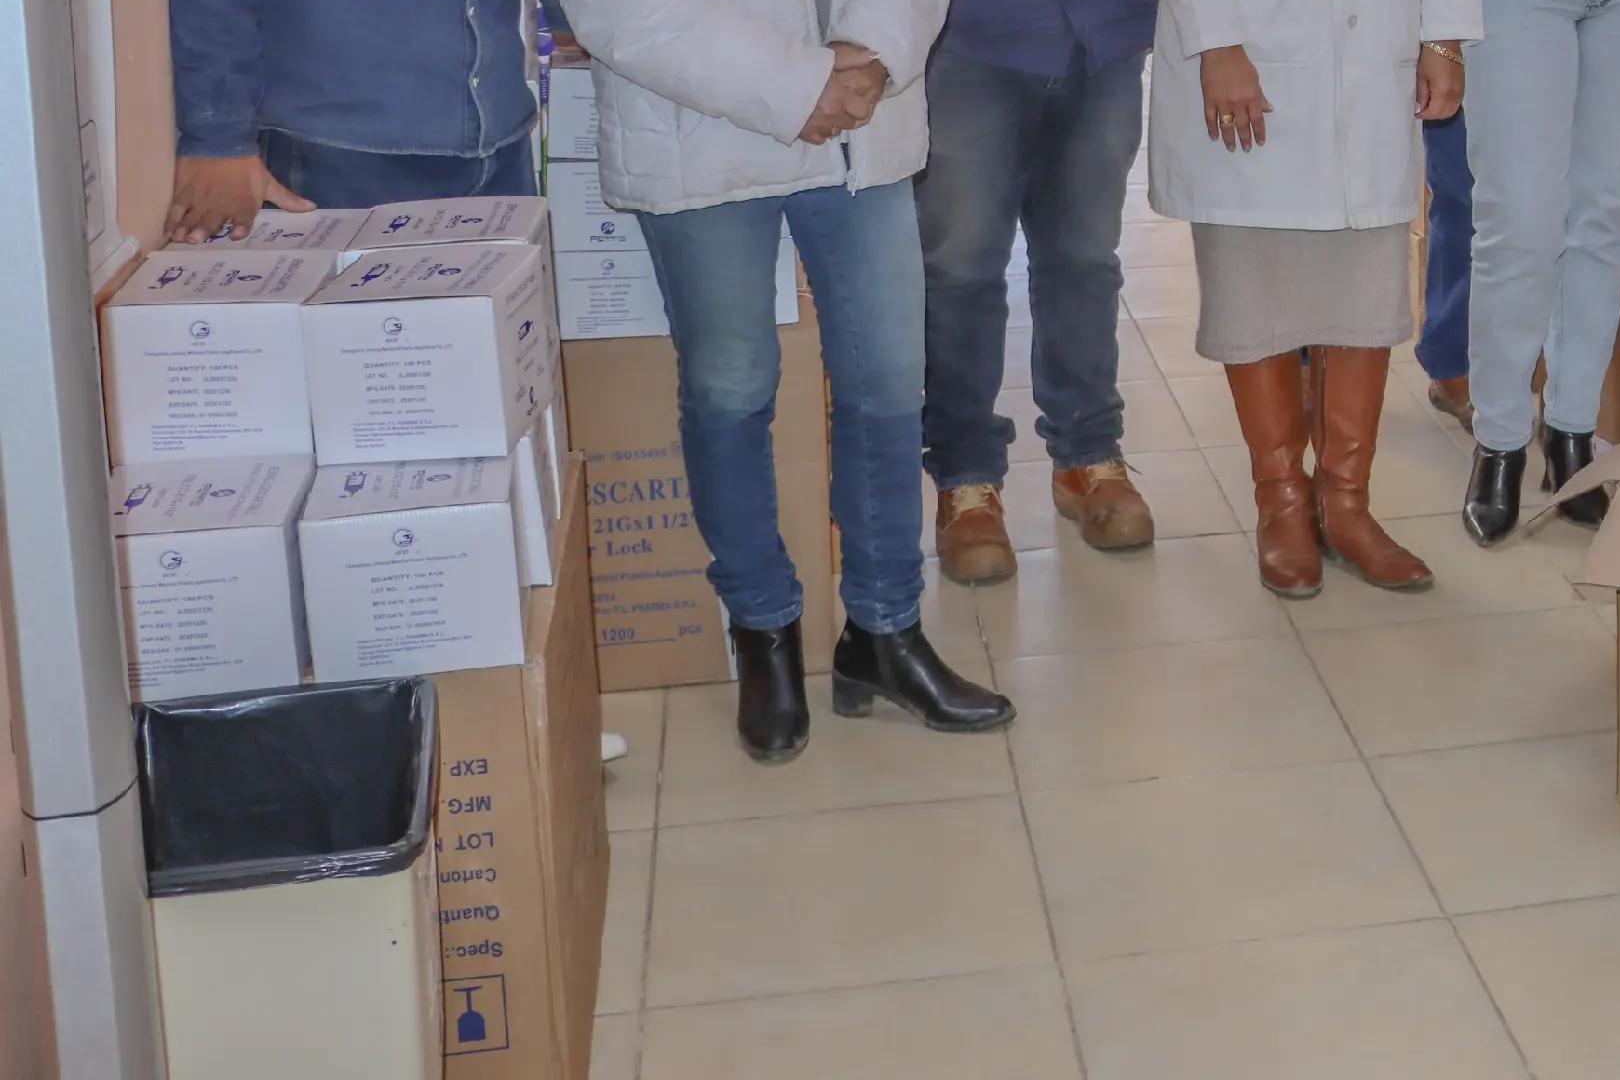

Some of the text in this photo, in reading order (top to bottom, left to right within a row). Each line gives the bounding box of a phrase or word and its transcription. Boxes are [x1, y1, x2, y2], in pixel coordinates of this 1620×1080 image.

[606, 538, 653, 556] Lock
[601, 628, 635, 642] 1200
[455, 832, 495, 851] LOT
[439, 867, 497, 885] Carton
[444, 940, 504, 959] Spec.:
